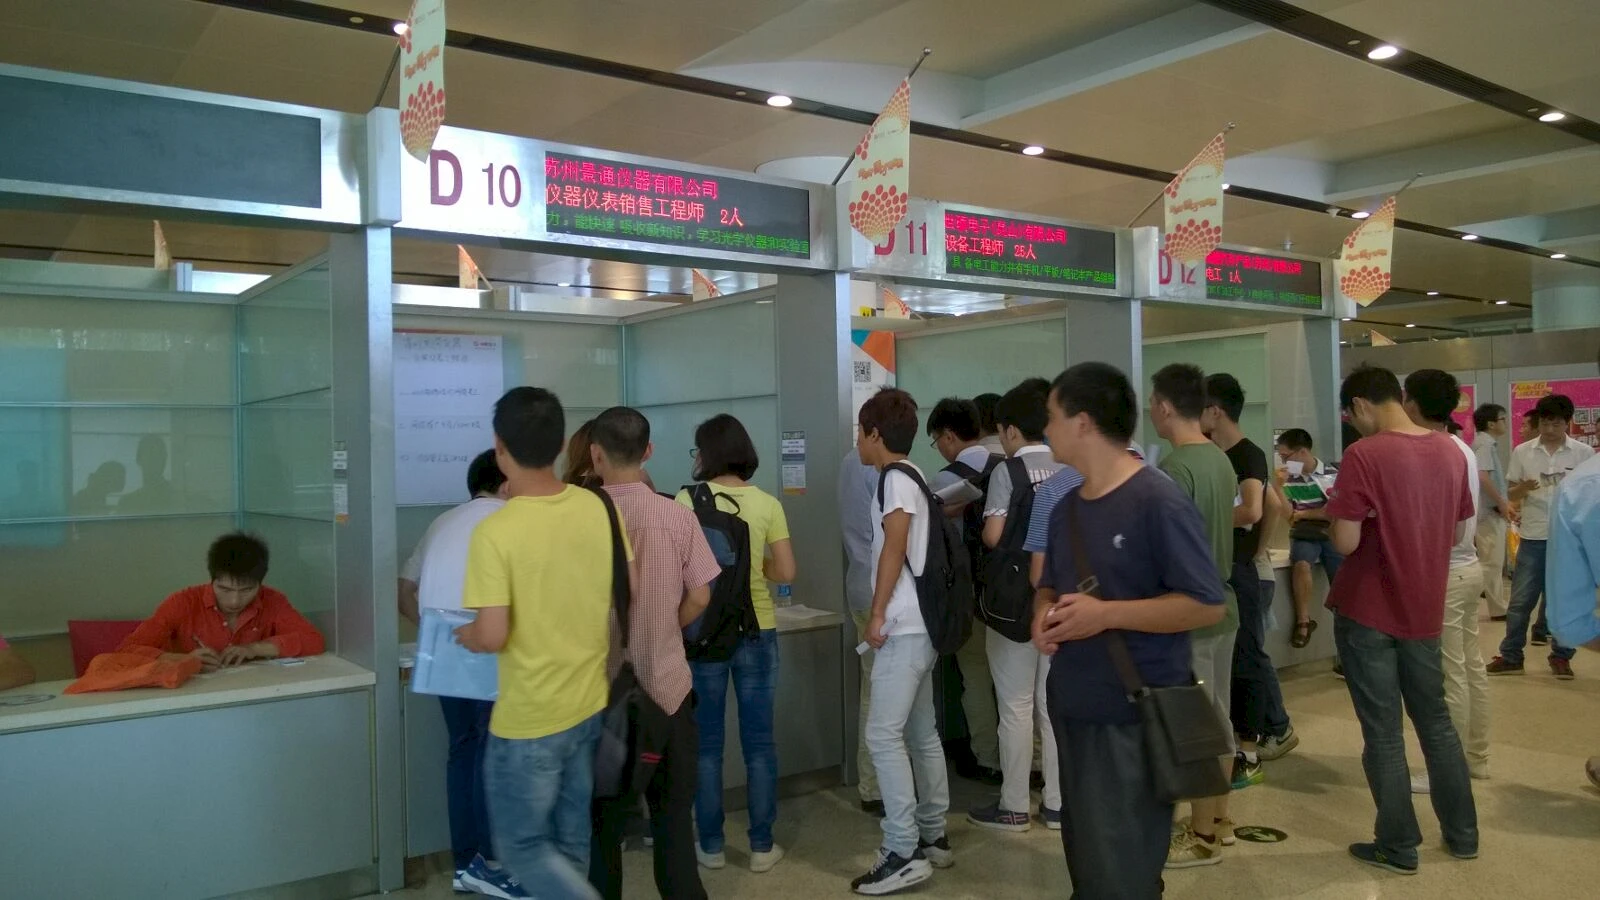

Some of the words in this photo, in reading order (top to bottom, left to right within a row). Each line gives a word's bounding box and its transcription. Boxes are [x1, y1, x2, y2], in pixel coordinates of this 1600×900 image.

[430, 149, 463, 206] D
[481, 162, 522, 208] 10
[544, 156, 718, 199] 苏州景通仪器有限公司
[544, 183, 705, 224] 仪器仪表销售工程师
[720, 207, 744, 228] 2人
[905, 220, 927, 255] 11
[944, 234, 1004, 257] 设备工程师
[1014, 243, 1037, 260] 25人
[1158, 249, 1173, 285] D
[1206, 267, 1222, 281] 电工
